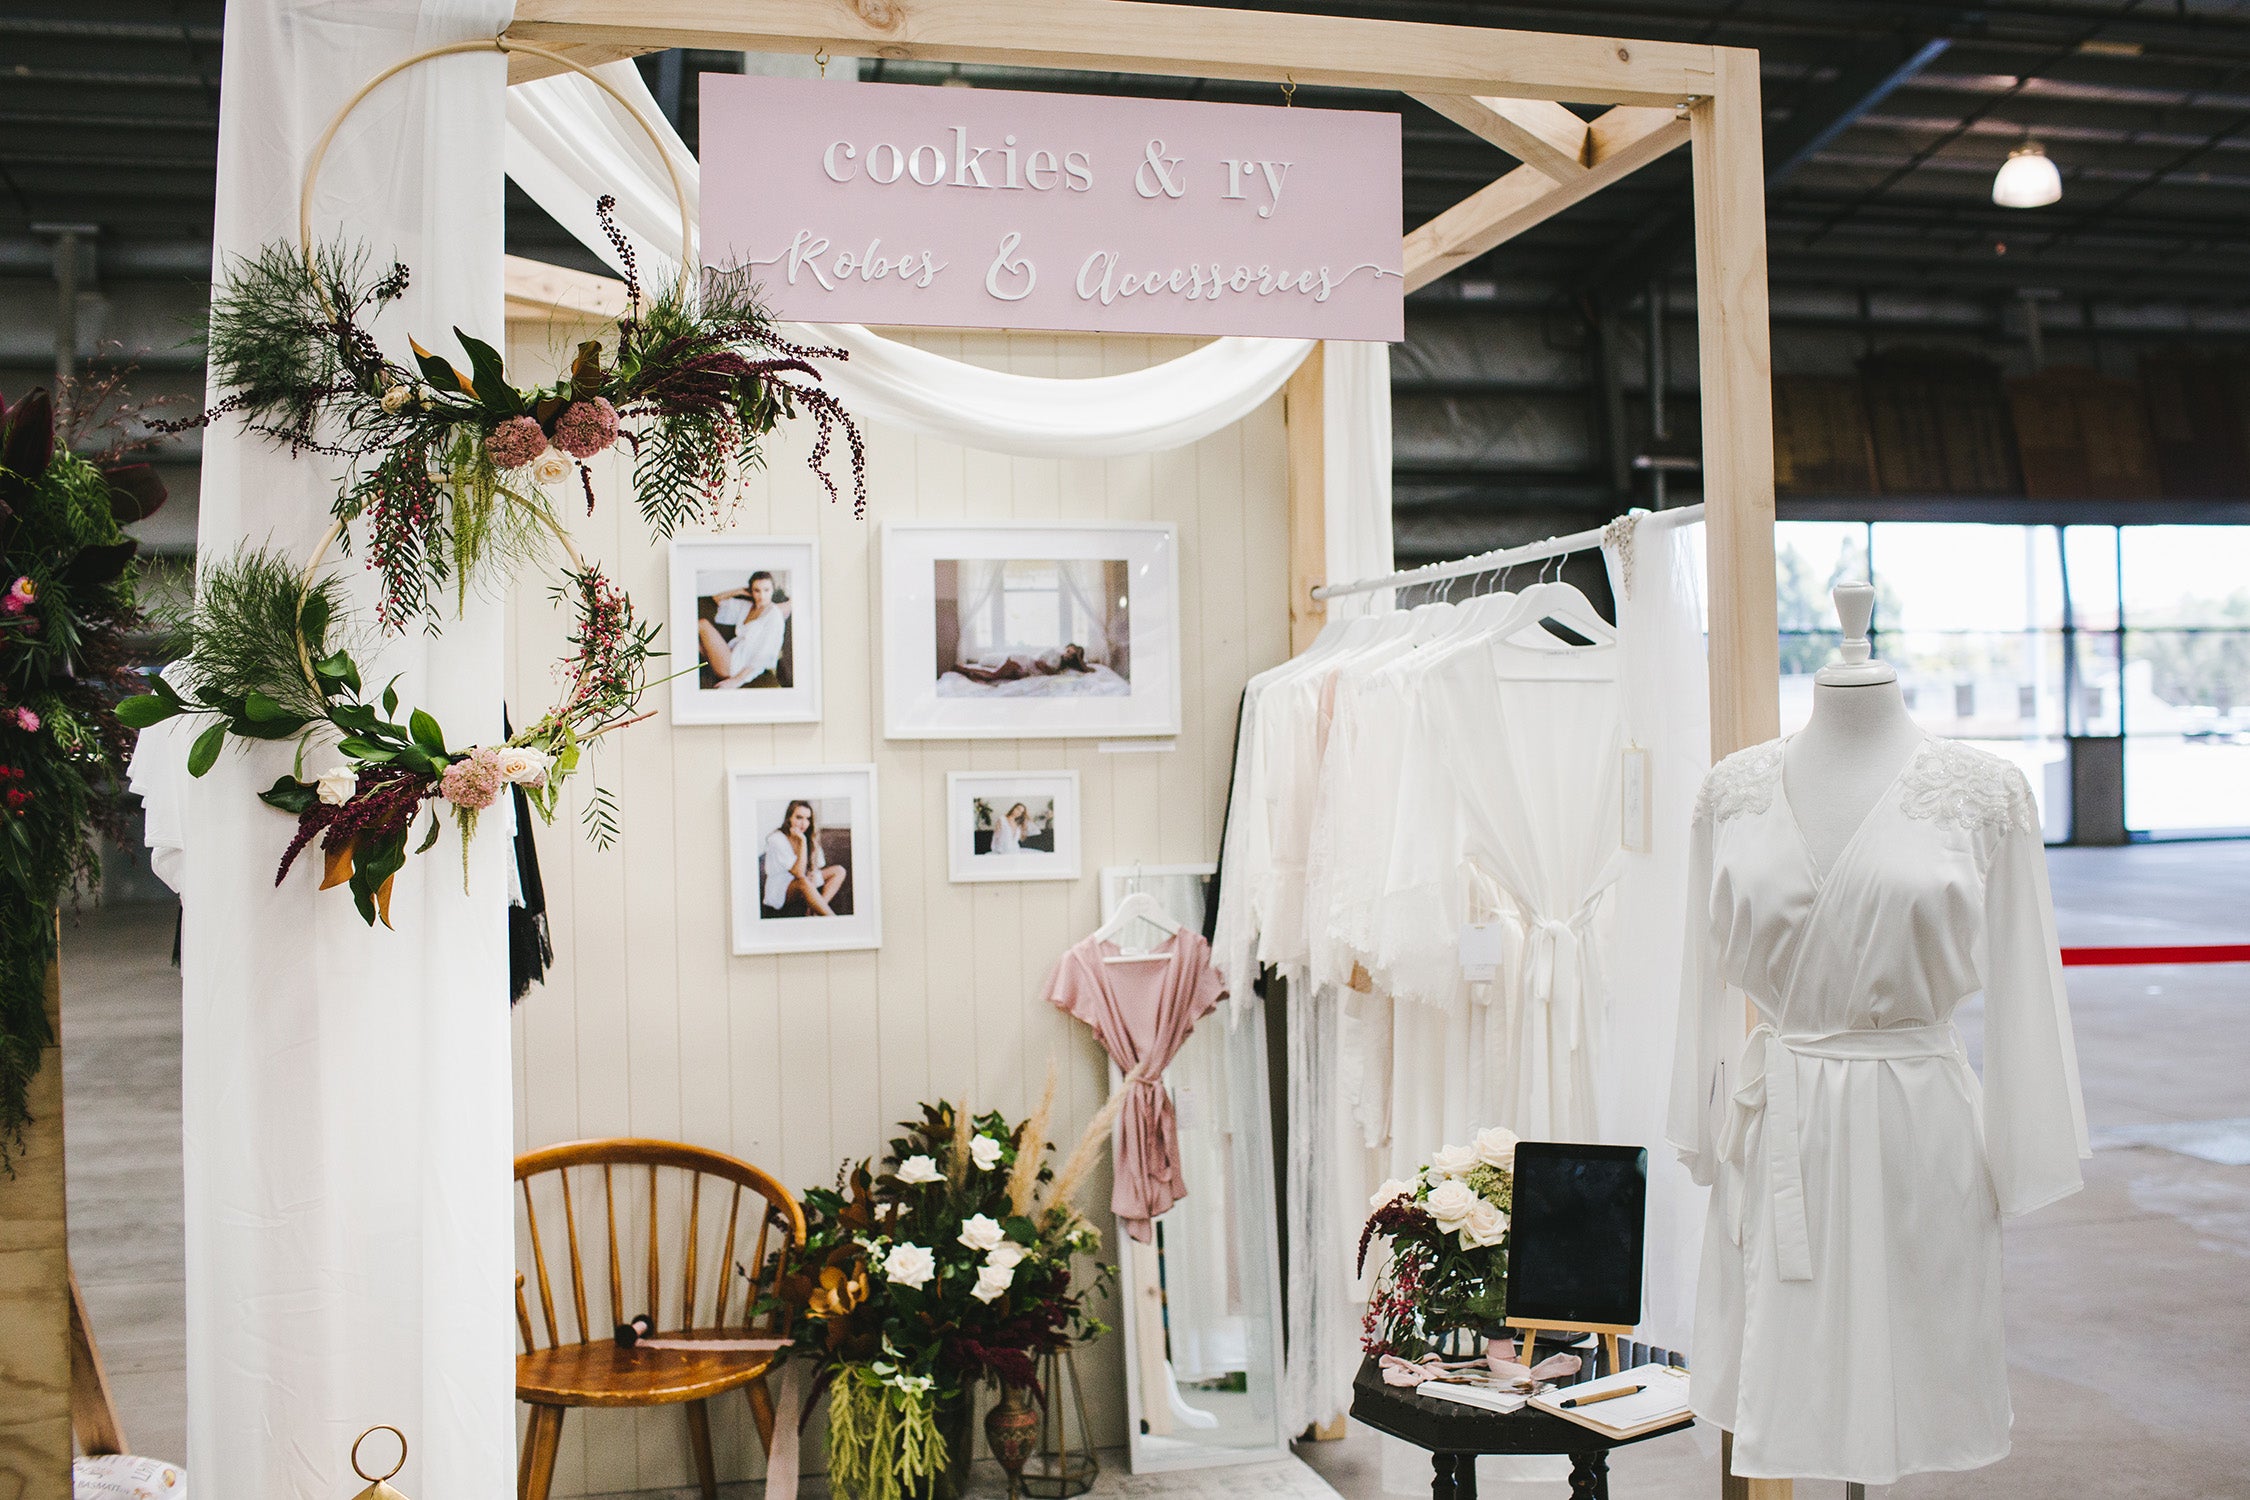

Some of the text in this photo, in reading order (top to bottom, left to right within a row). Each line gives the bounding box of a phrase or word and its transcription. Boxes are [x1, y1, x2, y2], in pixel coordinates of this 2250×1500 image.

[822, 125, 1293, 218] cookies & ry
[784, 228, 1340, 306] Robes & Accessories
